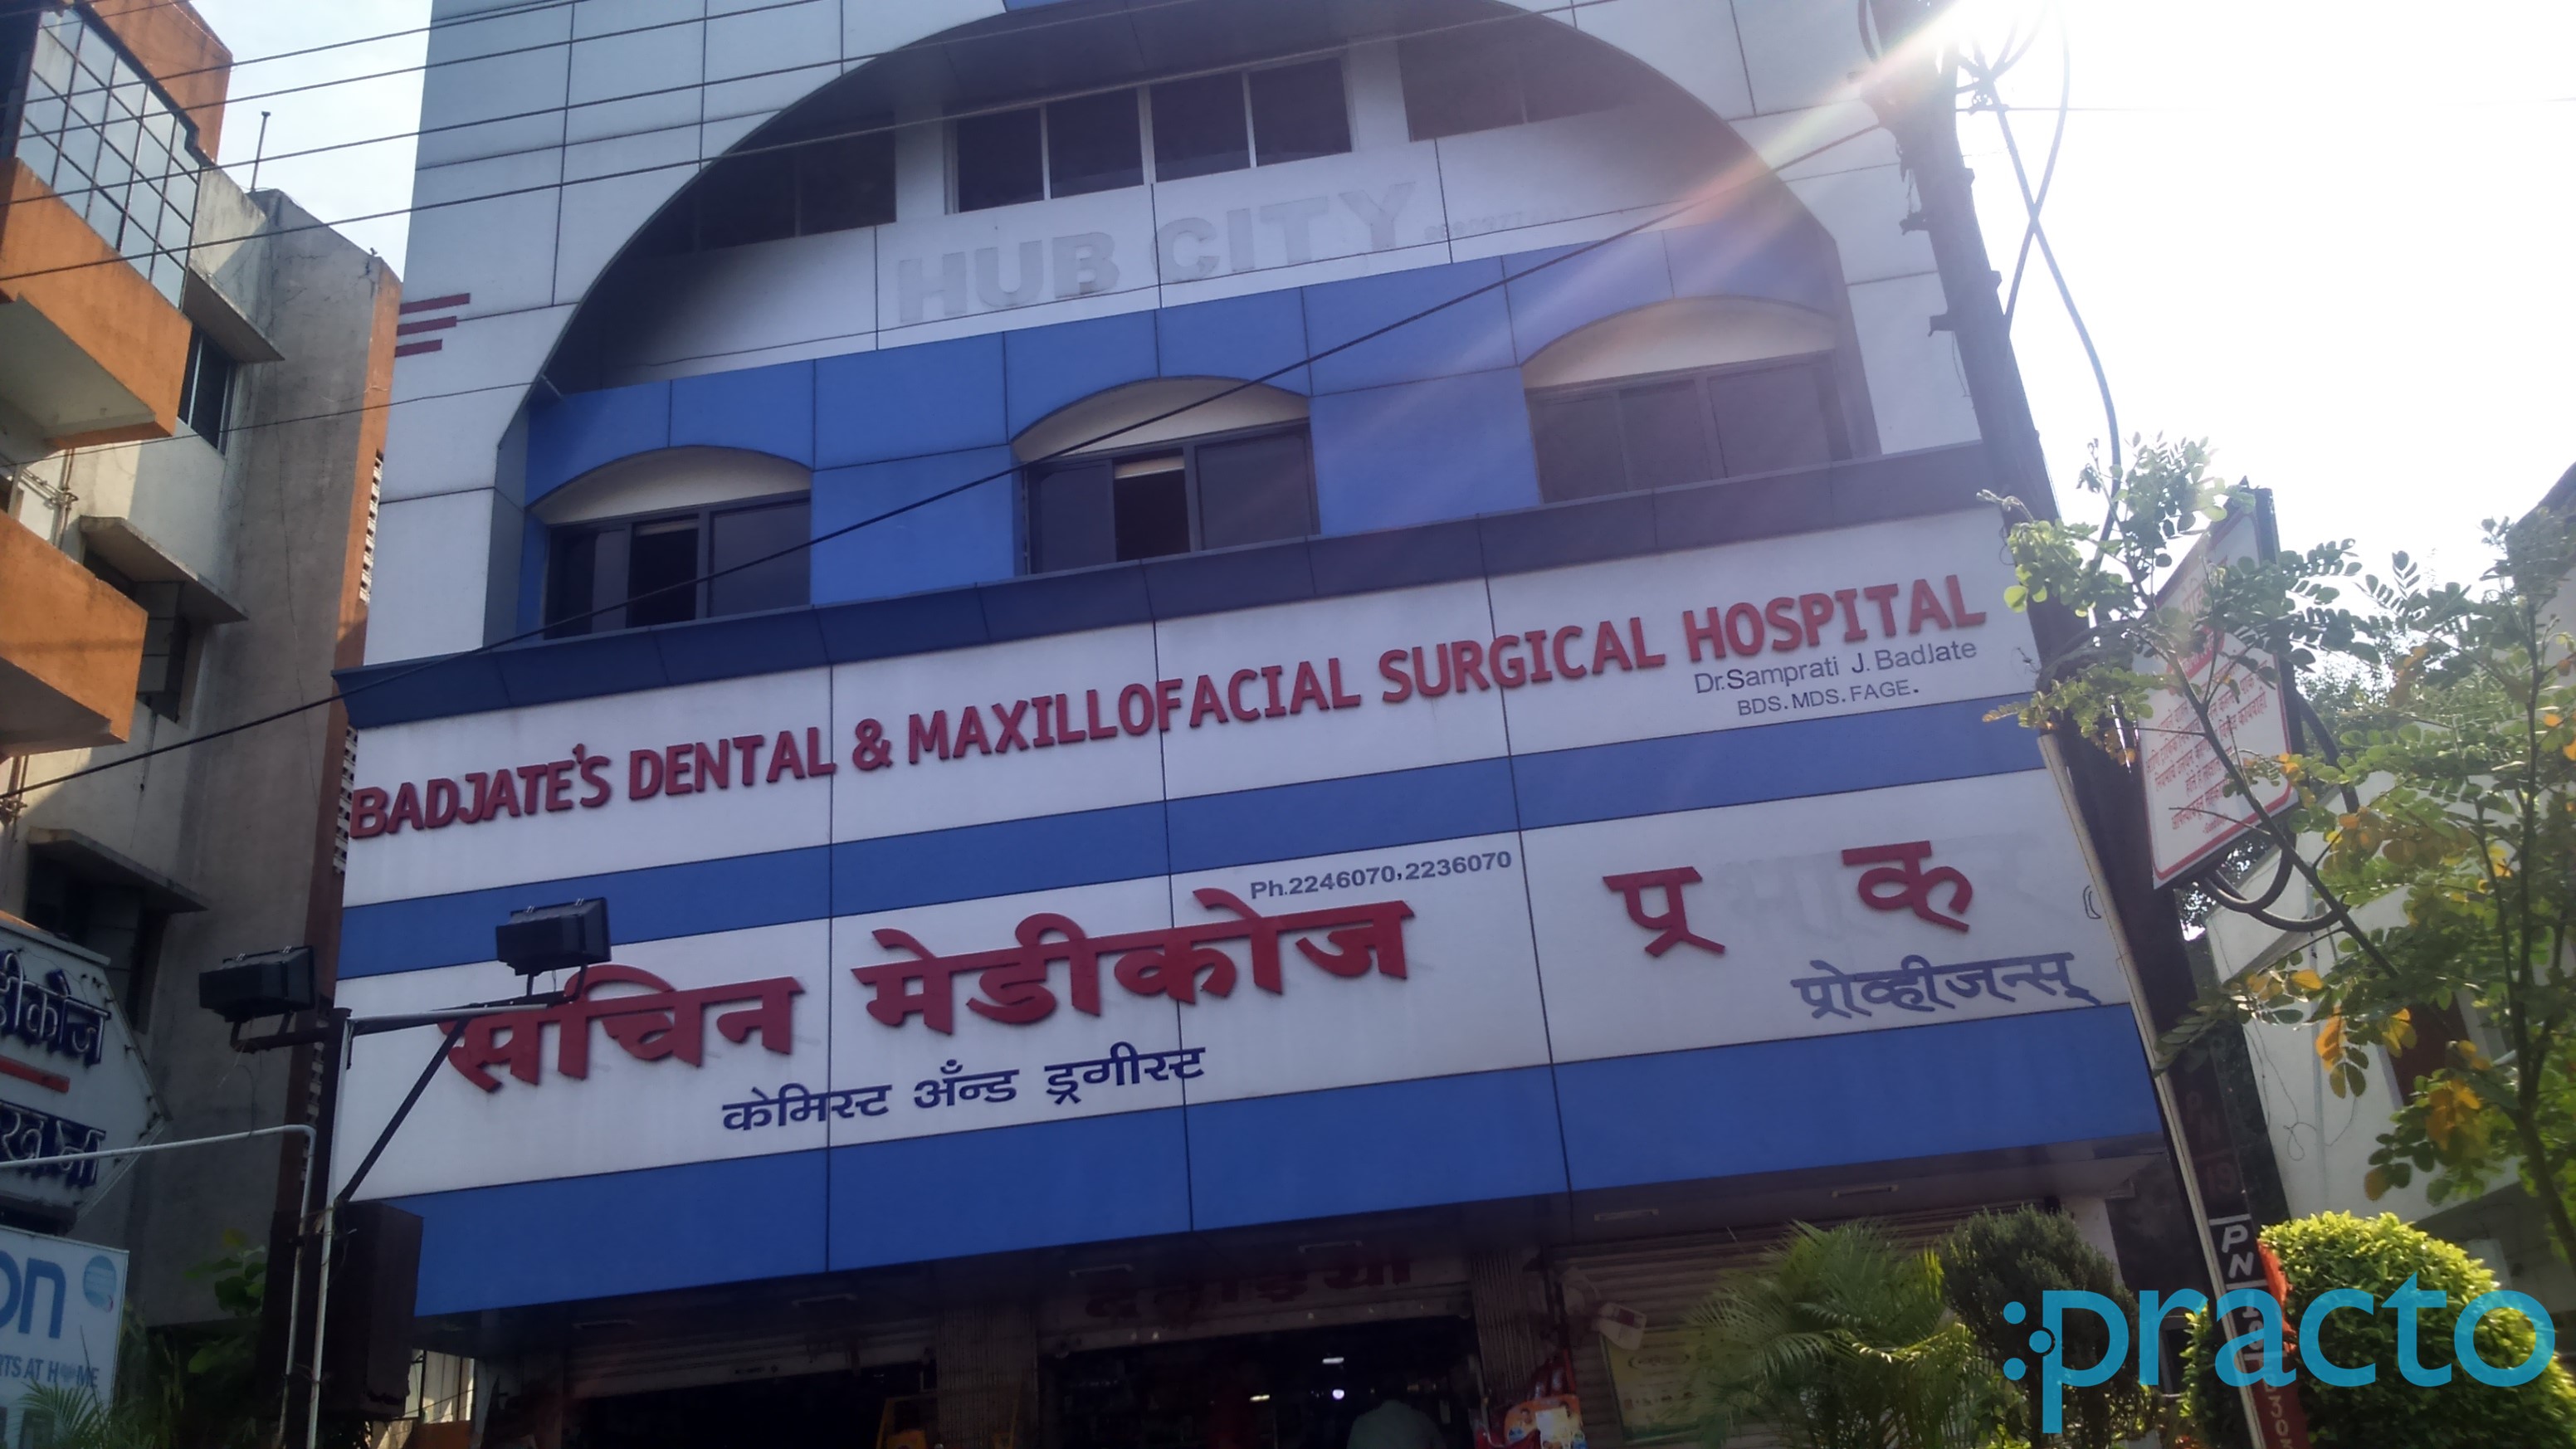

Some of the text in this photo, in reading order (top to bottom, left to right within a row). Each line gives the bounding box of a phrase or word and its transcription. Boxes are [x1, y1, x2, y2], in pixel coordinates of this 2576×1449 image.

[898, 180, 1416, 323] HUB CITY
[349, 573, 1988, 840] BADJATE'S DENTAL & MAXILLOFACIAL SURGICAL HOSPITAL
[851, 888, 1414, 1036] मेडीकोज
[722, 1082, 893, 1130] केमिस्ट
[23, 1358, 44, 1380] AT
